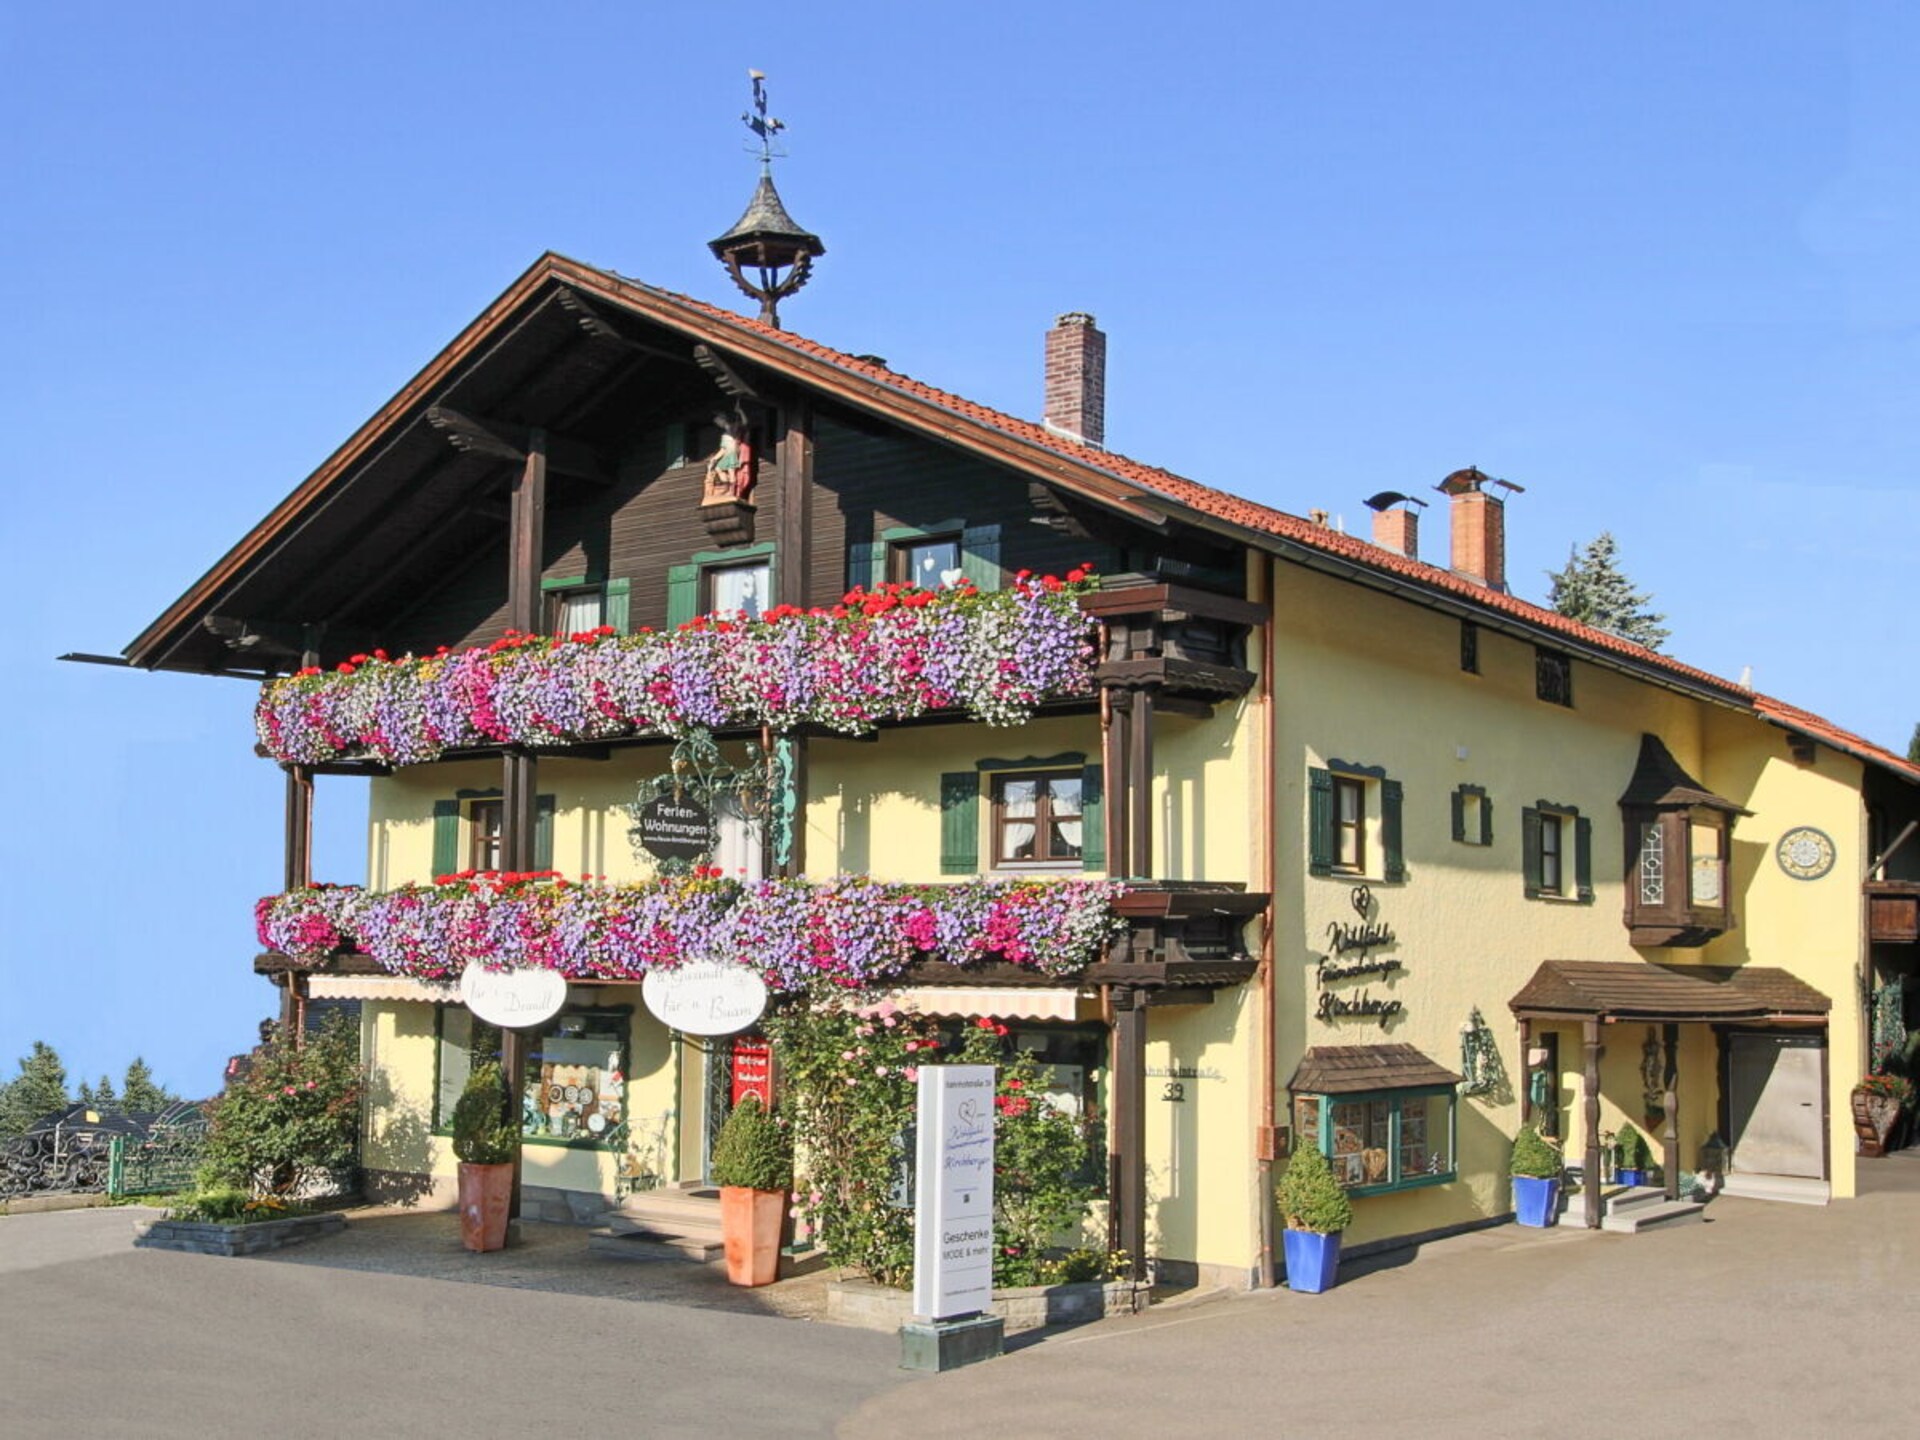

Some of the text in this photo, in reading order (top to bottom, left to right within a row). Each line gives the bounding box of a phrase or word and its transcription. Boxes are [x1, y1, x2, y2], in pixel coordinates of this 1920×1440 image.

[657, 803, 698, 818] Ferien-
[644, 818, 707, 836] Wohnungen
[1163, 1083, 1184, 1100] 39
[943, 1229, 989, 1244] Geschenke
